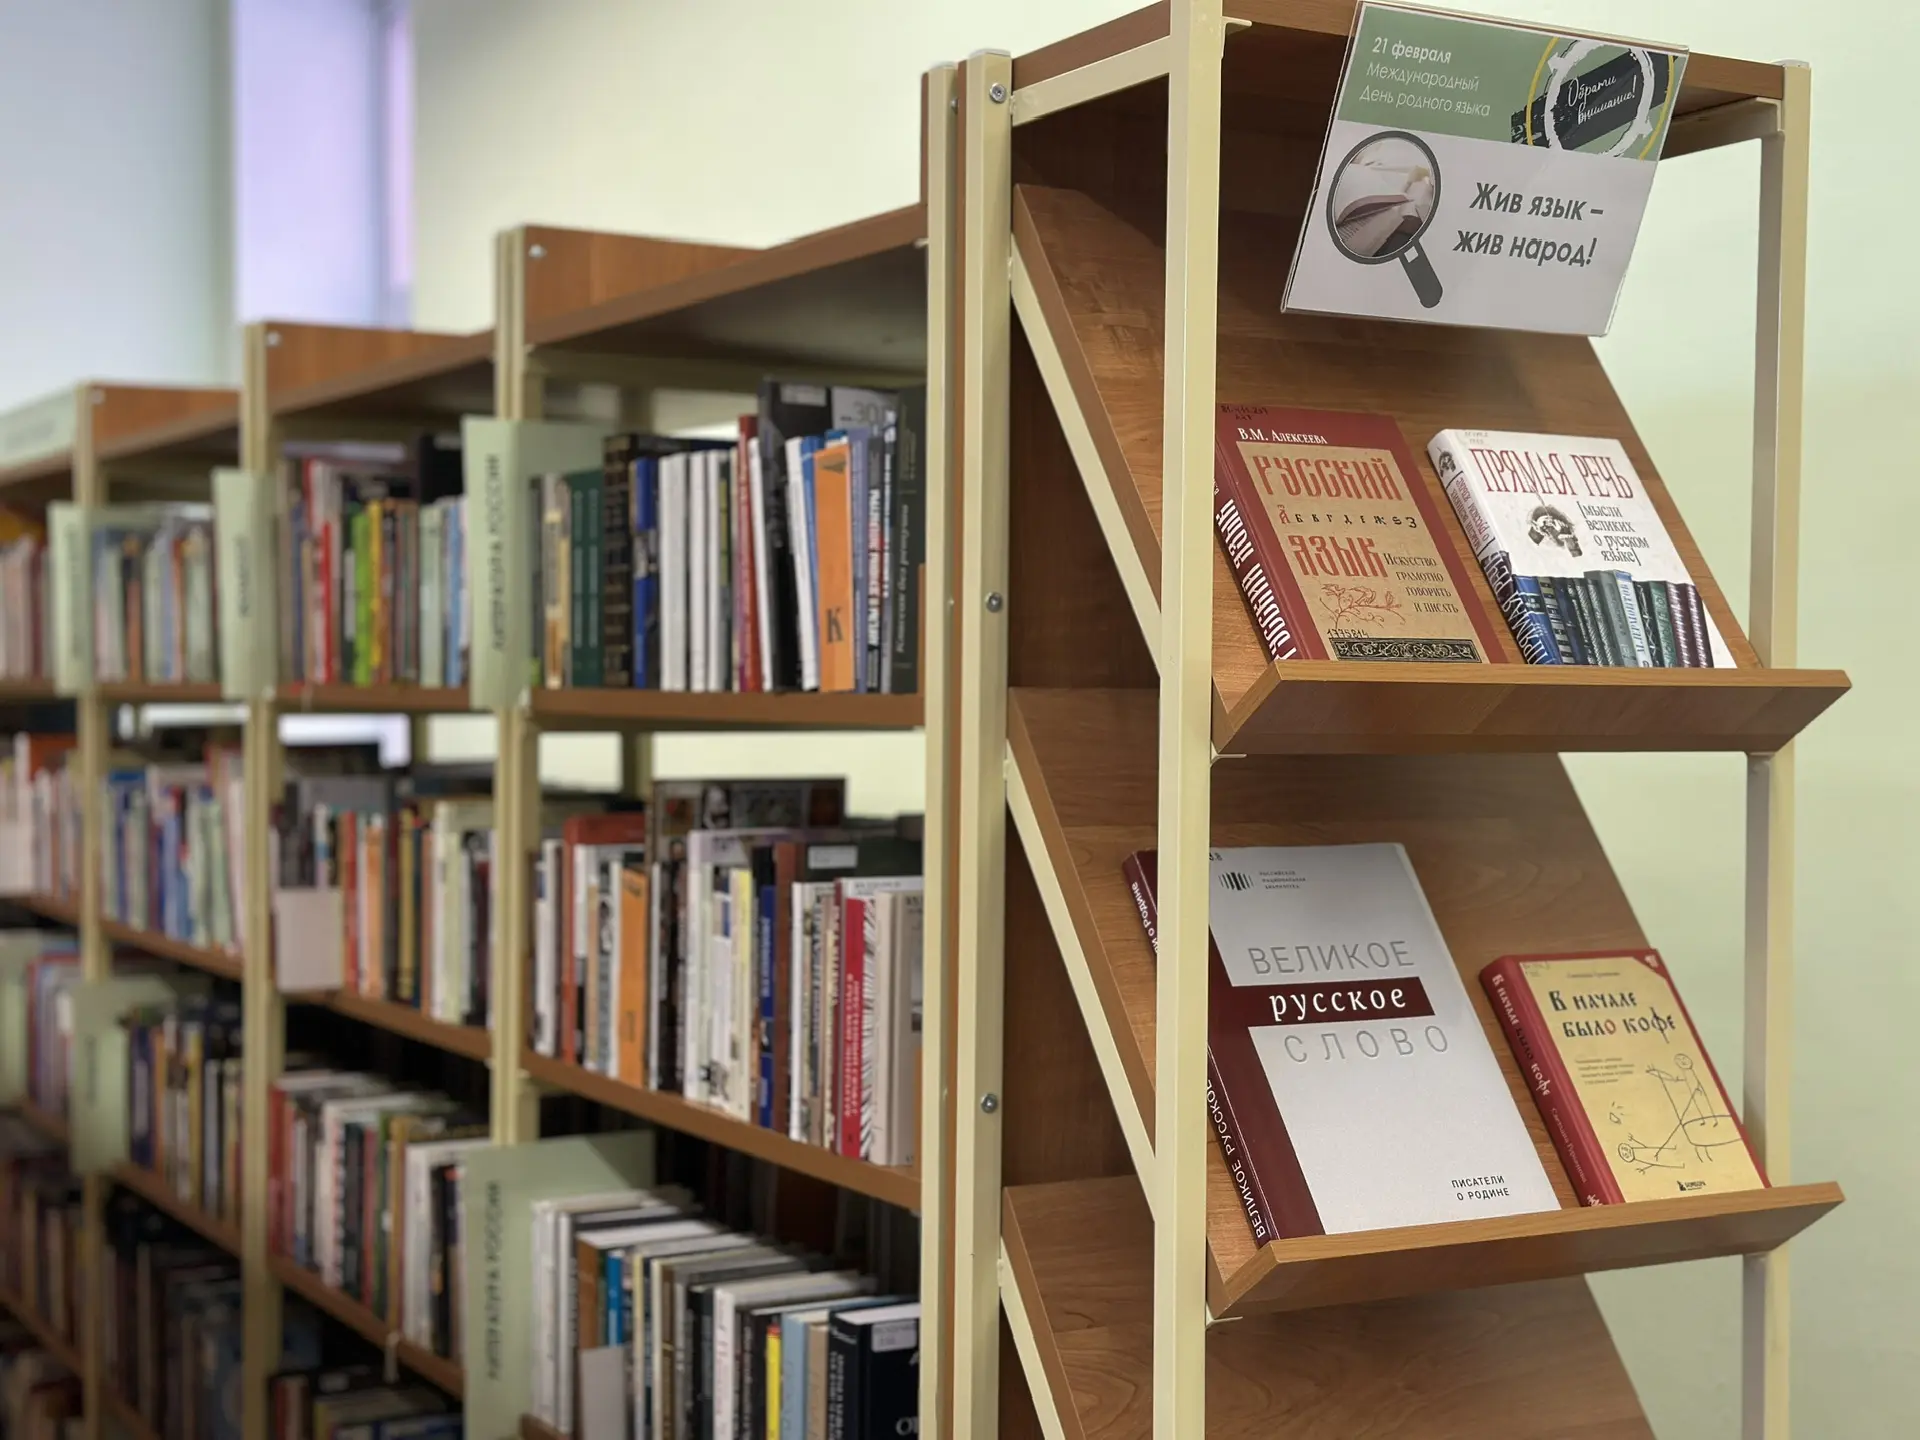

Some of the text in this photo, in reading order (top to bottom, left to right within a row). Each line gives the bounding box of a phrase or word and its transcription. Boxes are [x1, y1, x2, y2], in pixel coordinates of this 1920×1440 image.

[1372, 37, 1452, 64] 21 февраля
[1366, 61, 1480, 92] Международный
[1568, 76, 1617, 107] Обрати
[1359, 85, 1490, 117] День родного языка
[1578, 74, 1637, 125] внимание!
[1469, 181, 1522, 214] Жив
[1529, 194, 1586, 221] язык
[1453, 230, 1597, 267] жив народ!
[1237, 427, 1269, 441] В.М.
[1252, 455, 1403, 501] РУССКИЙ
[1469, 448, 1634, 499] ПРЯМАЯ РЕЧЬ
[1215, 499, 1255, 569] ЯЗЫК
[1586, 519, 1636, 533] великих
[1603, 535, 1650, 551] русском
[1288, 535, 1388, 578] ЯЗЫК
[1247, 940, 1415, 976] ВЕЛИКОЕ
[1269, 986, 1406, 1022] русское
[1284, 1024, 1450, 1063] СЛОВО
[1231, 1158, 1266, 1239] ВЕЛИКОЕ
[1451, 1174, 1505, 1189] ПИСАТЕЛИ
[1456, 1187, 1510, 1201] О РОДИНЕ
